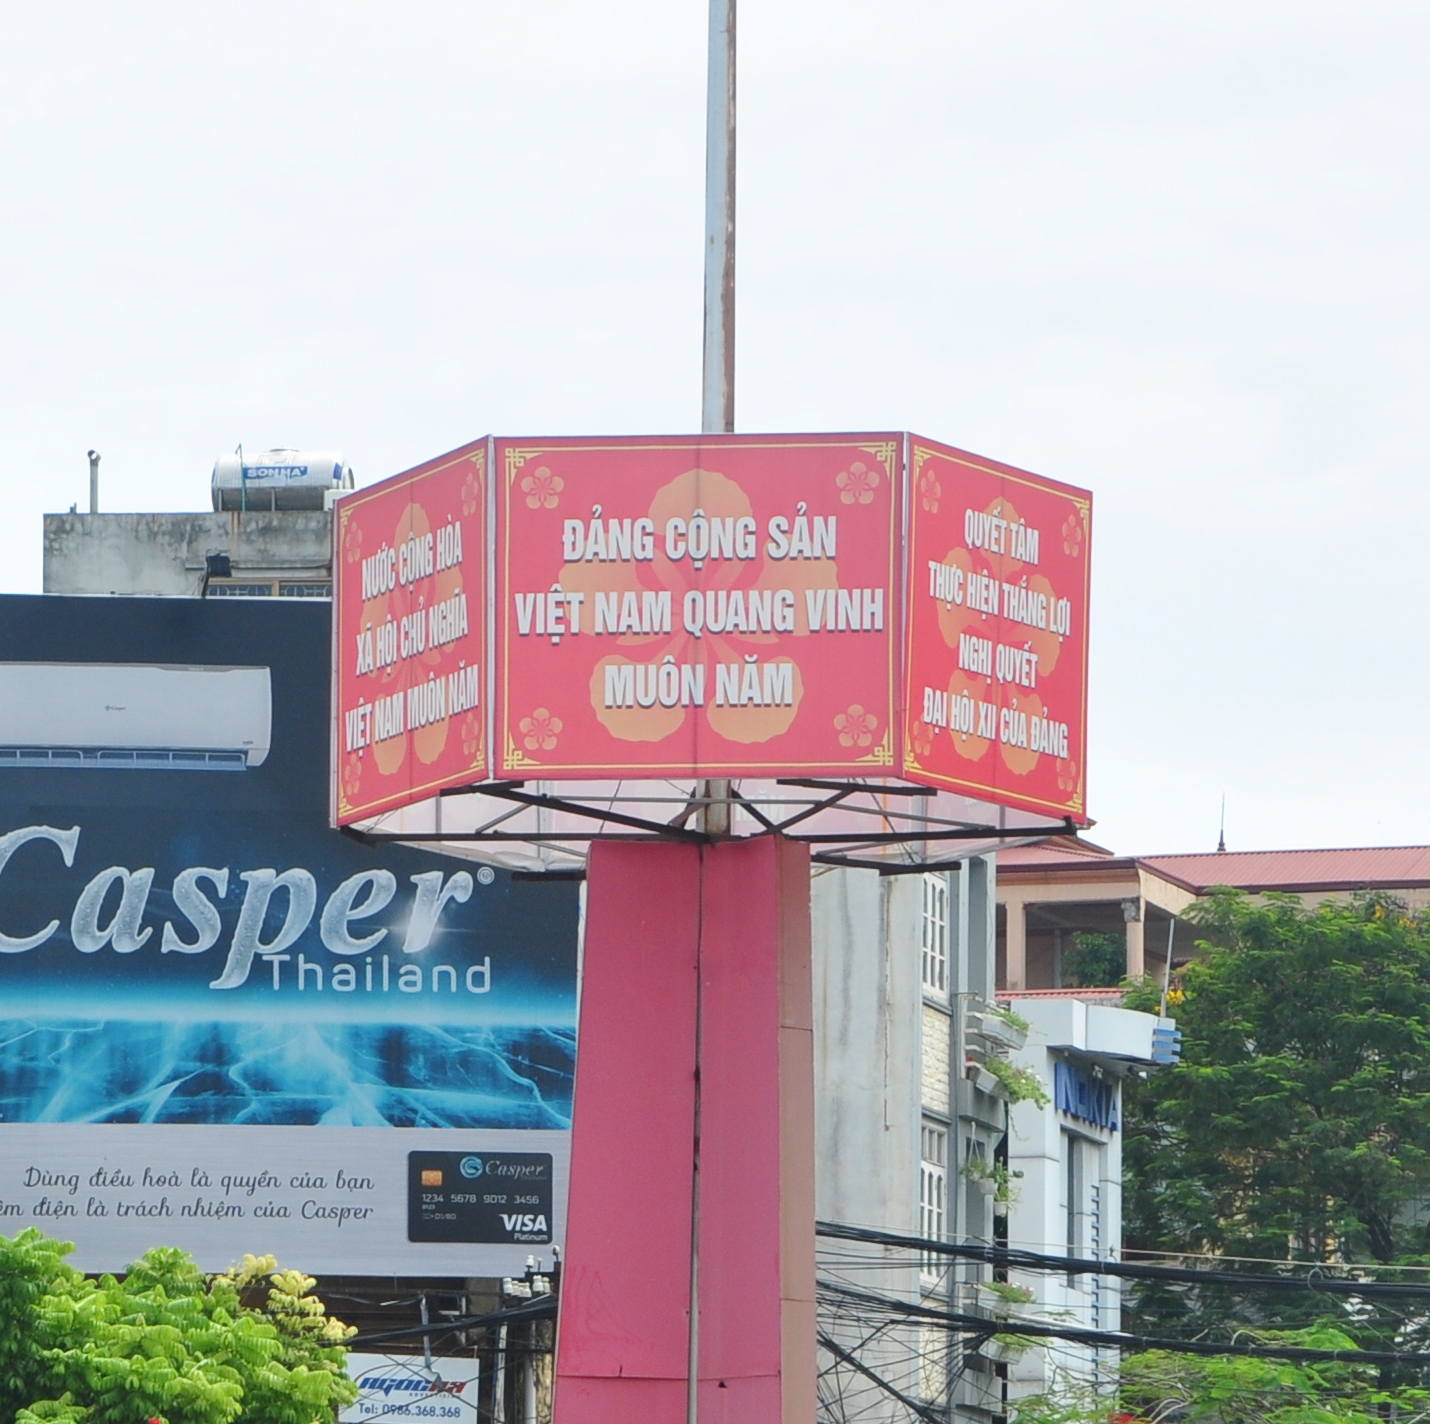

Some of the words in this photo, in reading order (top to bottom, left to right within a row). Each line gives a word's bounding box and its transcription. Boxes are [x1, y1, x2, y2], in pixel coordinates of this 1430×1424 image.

[362, 542, 396, 600] NƯỚC
[399, 532, 434, 592] CỘNG
[437, 514, 462, 572] HÒA
[562, 504, 654, 562] ĐẢNG
[665, 509, 756, 570] CỘNG
[767, 502, 837, 559] SẢN
[964, 507, 1007, 555] QUYẾT
[1010, 518, 1039, 565] TÂM
[515, 583, 584, 643] VIỆT
[594, 591, 671, 635] NAM
[683, 589, 795, 638] QUANG
[805, 588, 884, 633] VINH
[928, 560, 964, 610] THỰC
[967, 569, 999, 620] HIỆN
[1002, 575, 1046, 630] THẮNG
[1050, 597, 1071, 643] LỢI
[356, 624, 374, 676] XÃ
[377, 614, 397, 675] HỘI
[400, 596, 425, 659] CHỦ
[429, 588, 468, 649] NGHĨA
[604, 655, 705, 708] MUÔN
[715, 653, 793, 707] NĂM
[958, 633, 992, 684] NGHỊ
[995, 641, 1038, 689] QUYẾT
[345, 697, 371, 757] VIỆT
[375, 691, 404, 742] NAM
[407, 672, 446, 730] MUÔN
[449, 661, 479, 716] NĂM
[923, 686, 947, 734] ĐẠI
[950, 690, 975, 741] HỘI
[978, 701, 997, 740] XII
[1000, 698, 1027, 749] CỦA
[1030, 707, 1068, 760] ĐẢNG
[262, 954, 492, 994] Thailand
[1054, 1062, 1120, 1132] NOKIA
[23, 1166, 80, 1195] Dùng
[89, 1167, 135, 1187] điều
[142, 1167, 182, 1187] hoà
[190, 1167, 212, 1187] là
[220, 1170, 281, 1196] quyền
[289, 1171, 327, 1189] của
[335, 1169, 375, 1192] bạn
[485, 1160, 544, 1180] Casper
[32, 1197, 78, 1219] điện
[86, 1197, 108, 1217] là
[117, 1197, 173, 1217] trách
[181, 1197, 245, 1220] nhiệm
[253, 1201, 291, 1218] của
[301, 1200, 374, 1227] Casper
[422, 1193, 444, 1203] 1234
[451, 1194, 477, 1203] 5678
[483, 1194, 507, 1204] 9012
[513, 1195, 539, 1204] 3456
[499, 1214, 548, 1231] VISA
[514, 1233, 548, 1241] Platinum
[359, 1403, 379, 1414] Tel:
